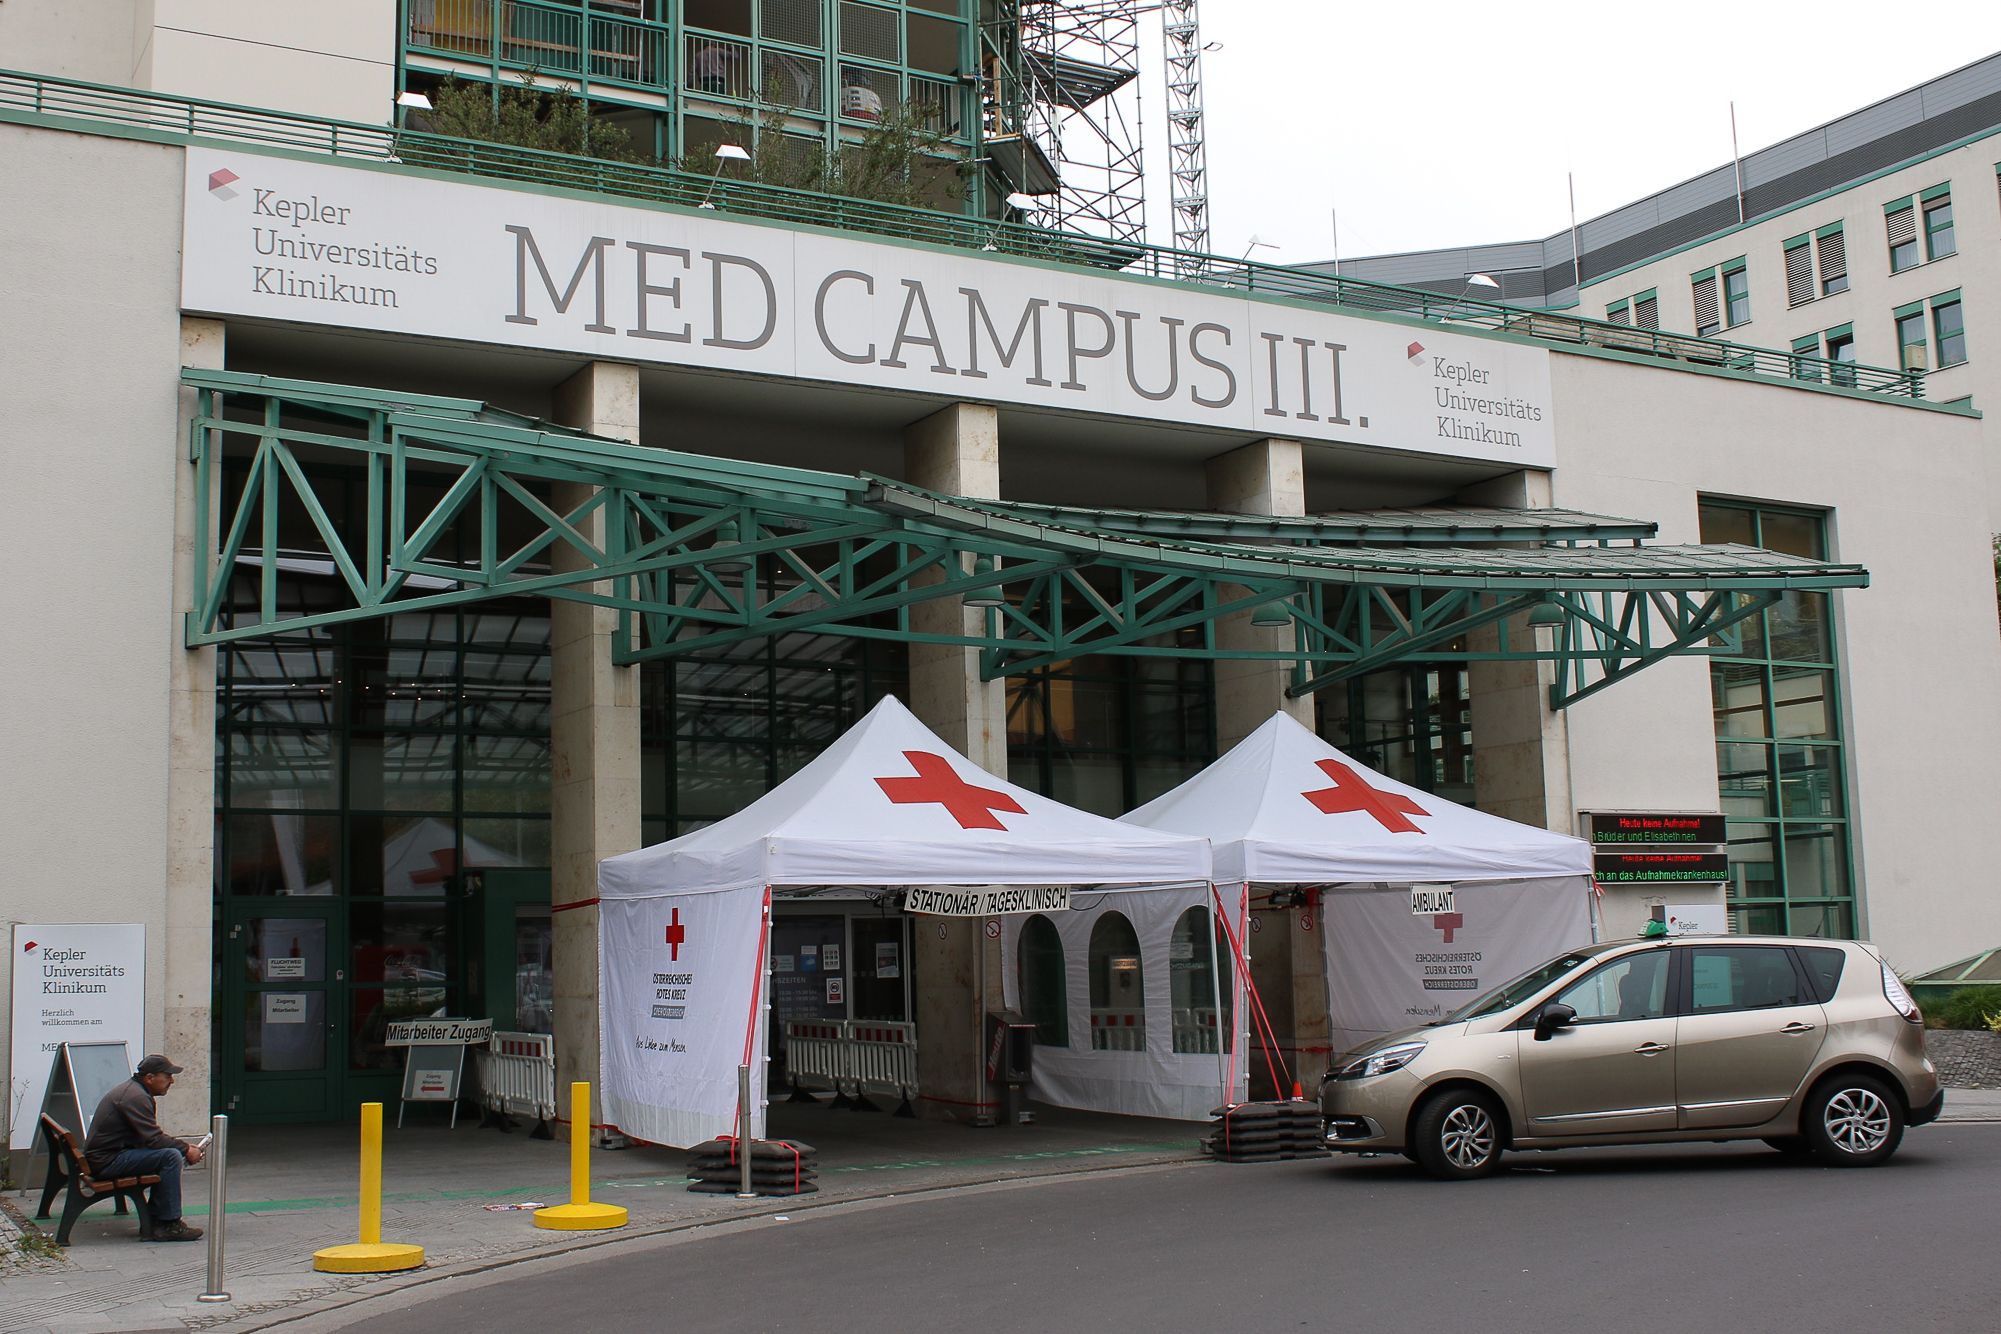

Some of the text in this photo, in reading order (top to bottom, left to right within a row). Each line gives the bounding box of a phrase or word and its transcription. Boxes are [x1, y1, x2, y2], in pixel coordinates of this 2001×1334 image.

[252, 188, 350, 228] Kepler
[252, 227, 438, 275] Universitäts
[252, 265, 399, 308] Klinikum
[505, 224, 1369, 428] MED CAMPUS III.
[1433, 356, 1489, 386] Kepler
[1435, 386, 1542, 421] Universitäts
[1437, 415, 1522, 447] Klinikum
[1619, 818, 1641, 828] Heute
[1643, 818, 1662, 828] keine
[1628, 832, 1643, 841] und
[1606, 872, 1617, 880] an
[1619, 870, 1634, 880] das
[909, 889, 979, 915] STATIONÄR
[985, 886, 1068, 914] TAGESKLINISCH
[1412, 891, 1454, 913] AMBULANT
[1678, 920, 1699, 932] Kepler
[43, 948, 87, 963] Kepler
[43, 964, 125, 978] Universitäts
[43, 981, 107, 994] Klinikum
[41, 1008, 75, 1017] Herzlich
[41, 1018, 103, 1026] willkommen am
[386, 1023, 491, 1043] Mitarbeiter Zugang
[41, 1043, 58, 1052] ME
